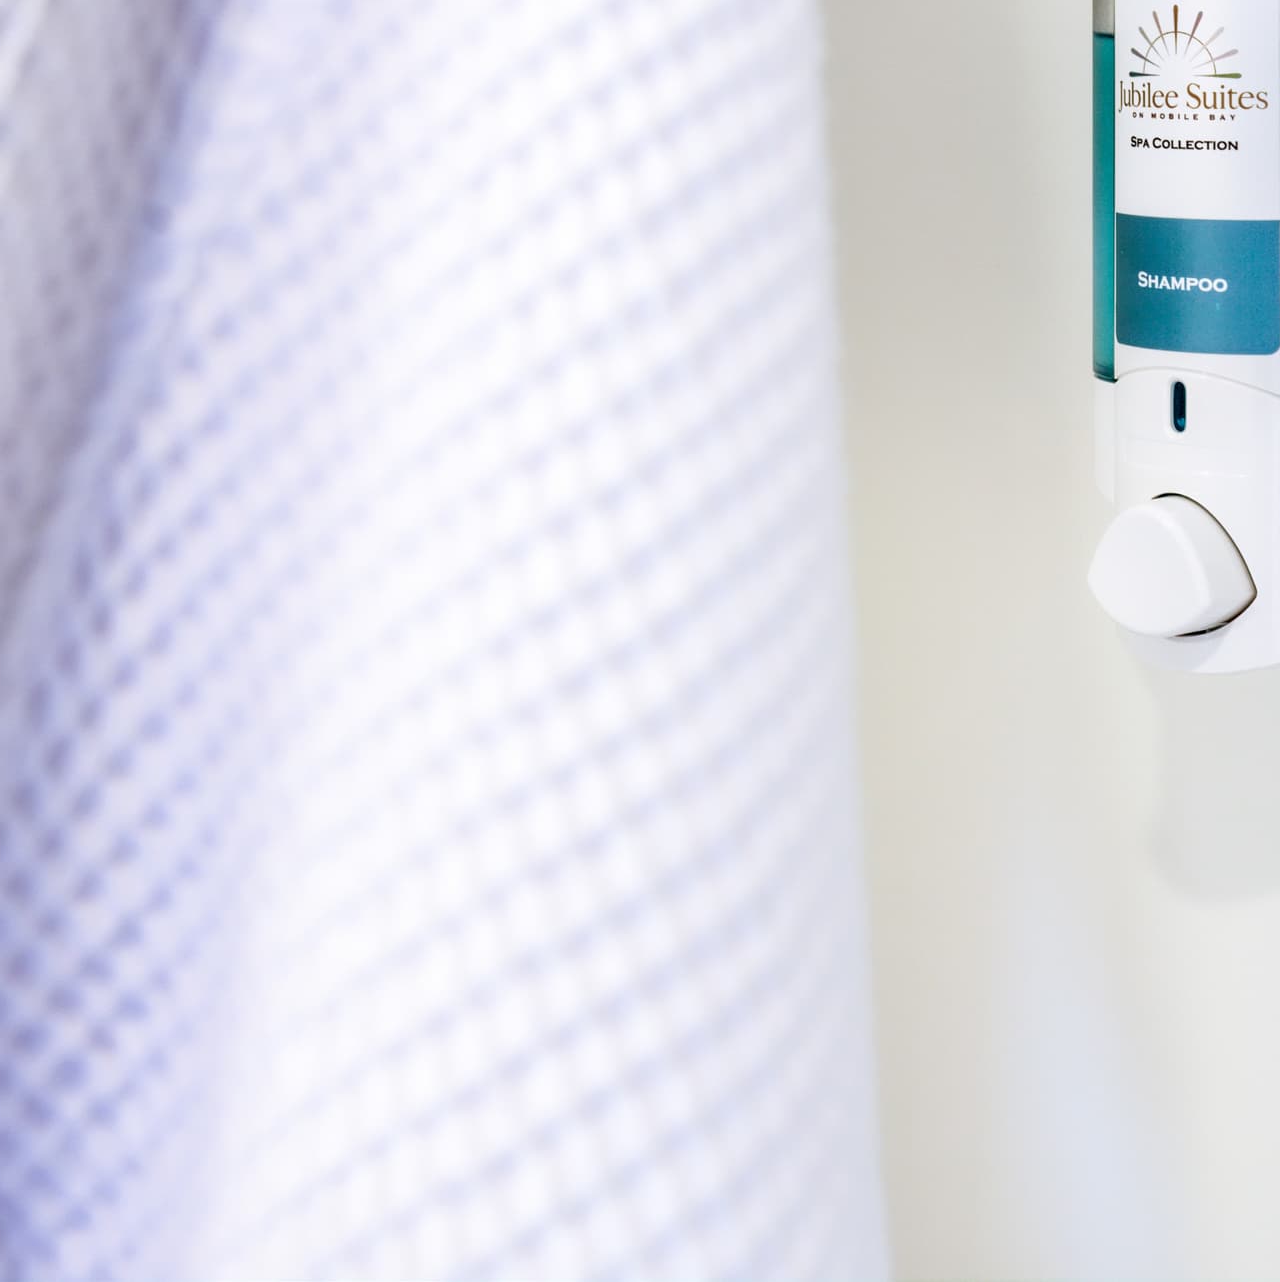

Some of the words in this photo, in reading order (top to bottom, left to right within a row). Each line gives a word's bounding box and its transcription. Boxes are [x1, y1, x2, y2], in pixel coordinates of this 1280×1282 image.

[1118, 80, 1179, 114] Jubilee
[1185, 82, 1270, 111] Suites
[1151, 112, 1200, 121] MOBILE
[1209, 113, 1237, 122] BAY
